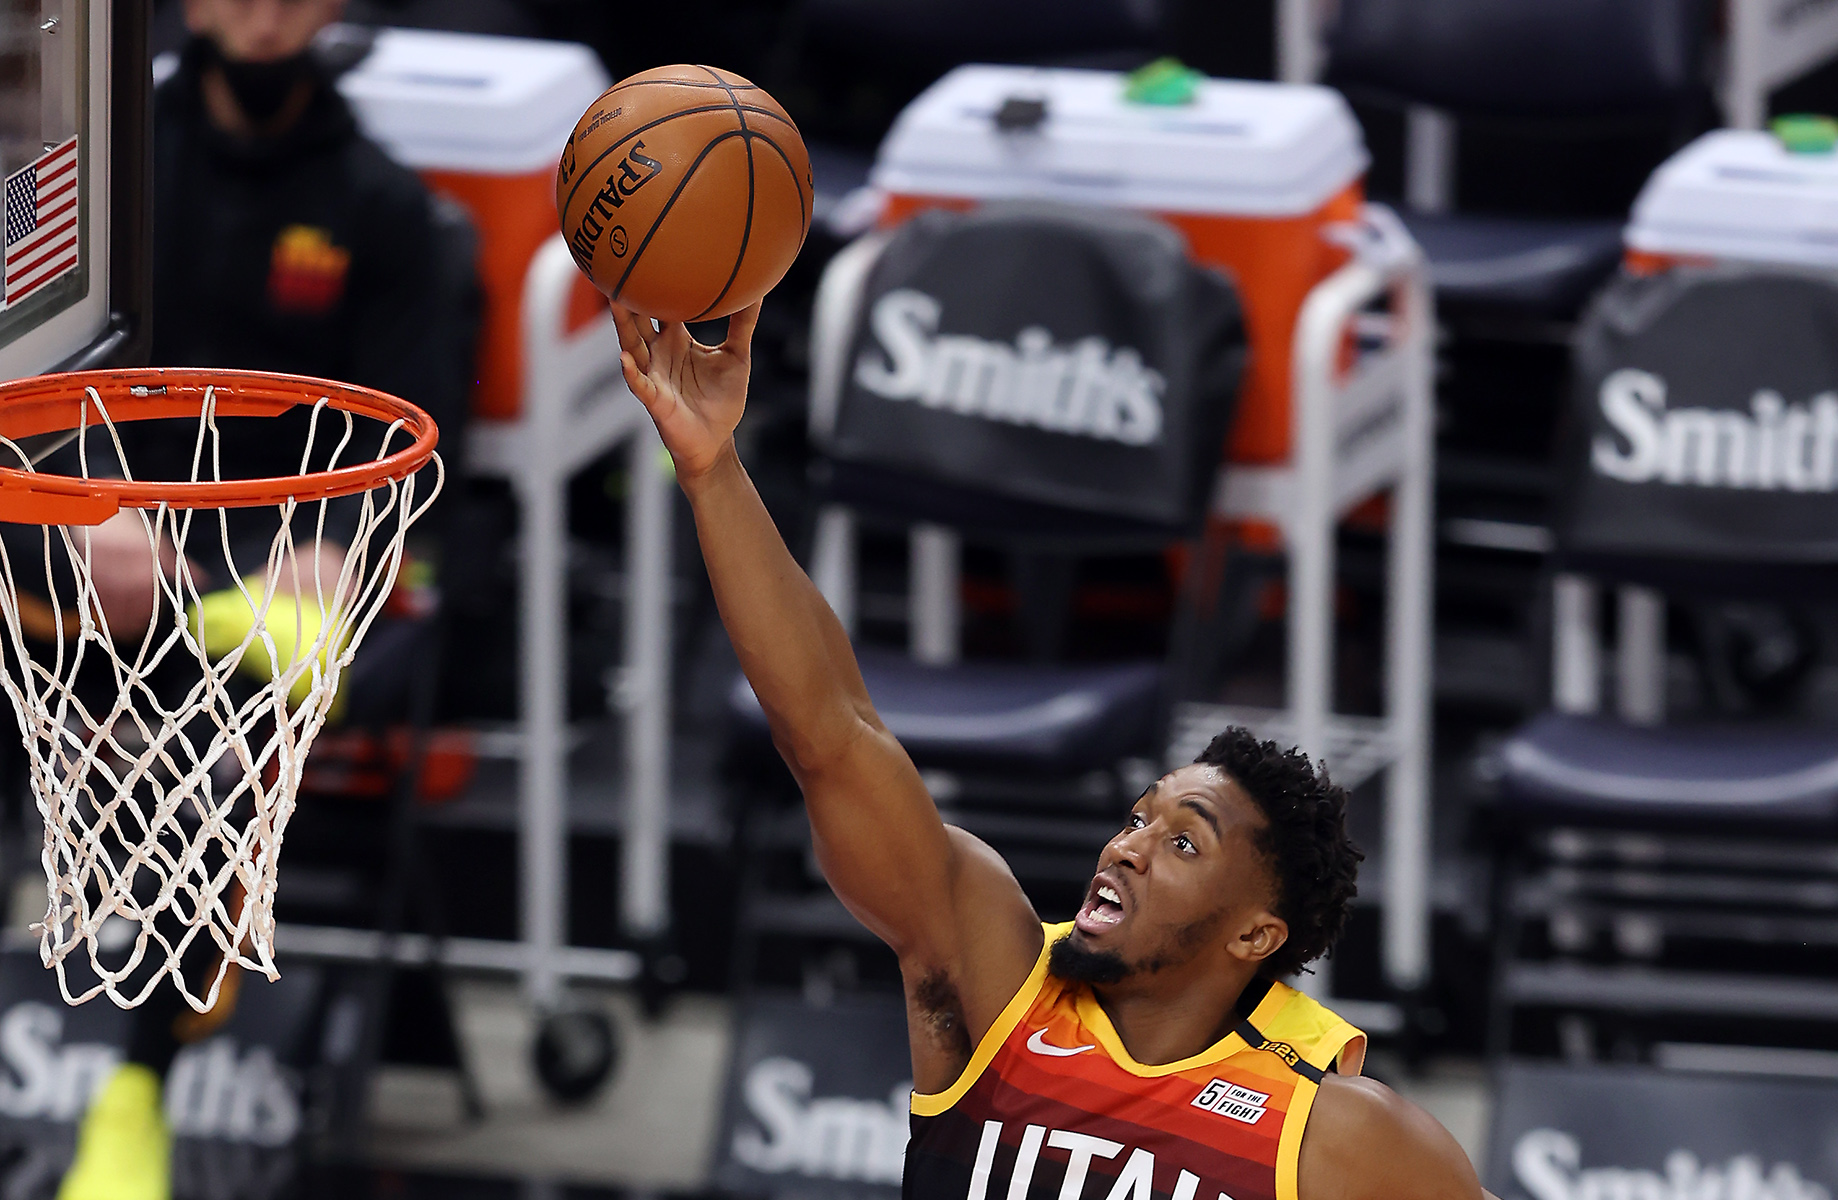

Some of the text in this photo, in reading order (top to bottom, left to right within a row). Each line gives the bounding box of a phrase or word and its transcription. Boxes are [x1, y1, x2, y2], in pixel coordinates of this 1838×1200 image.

[571, 140, 663, 284] SPALDIN
[854, 288, 1167, 447] Smith's
[1256, 1040, 1300, 1068] 1223
[1198, 1082, 1226, 1106] 5
[1230, 1088, 1263, 1104] FOR THE
[1217, 1100, 1261, 1121] FIGHT
